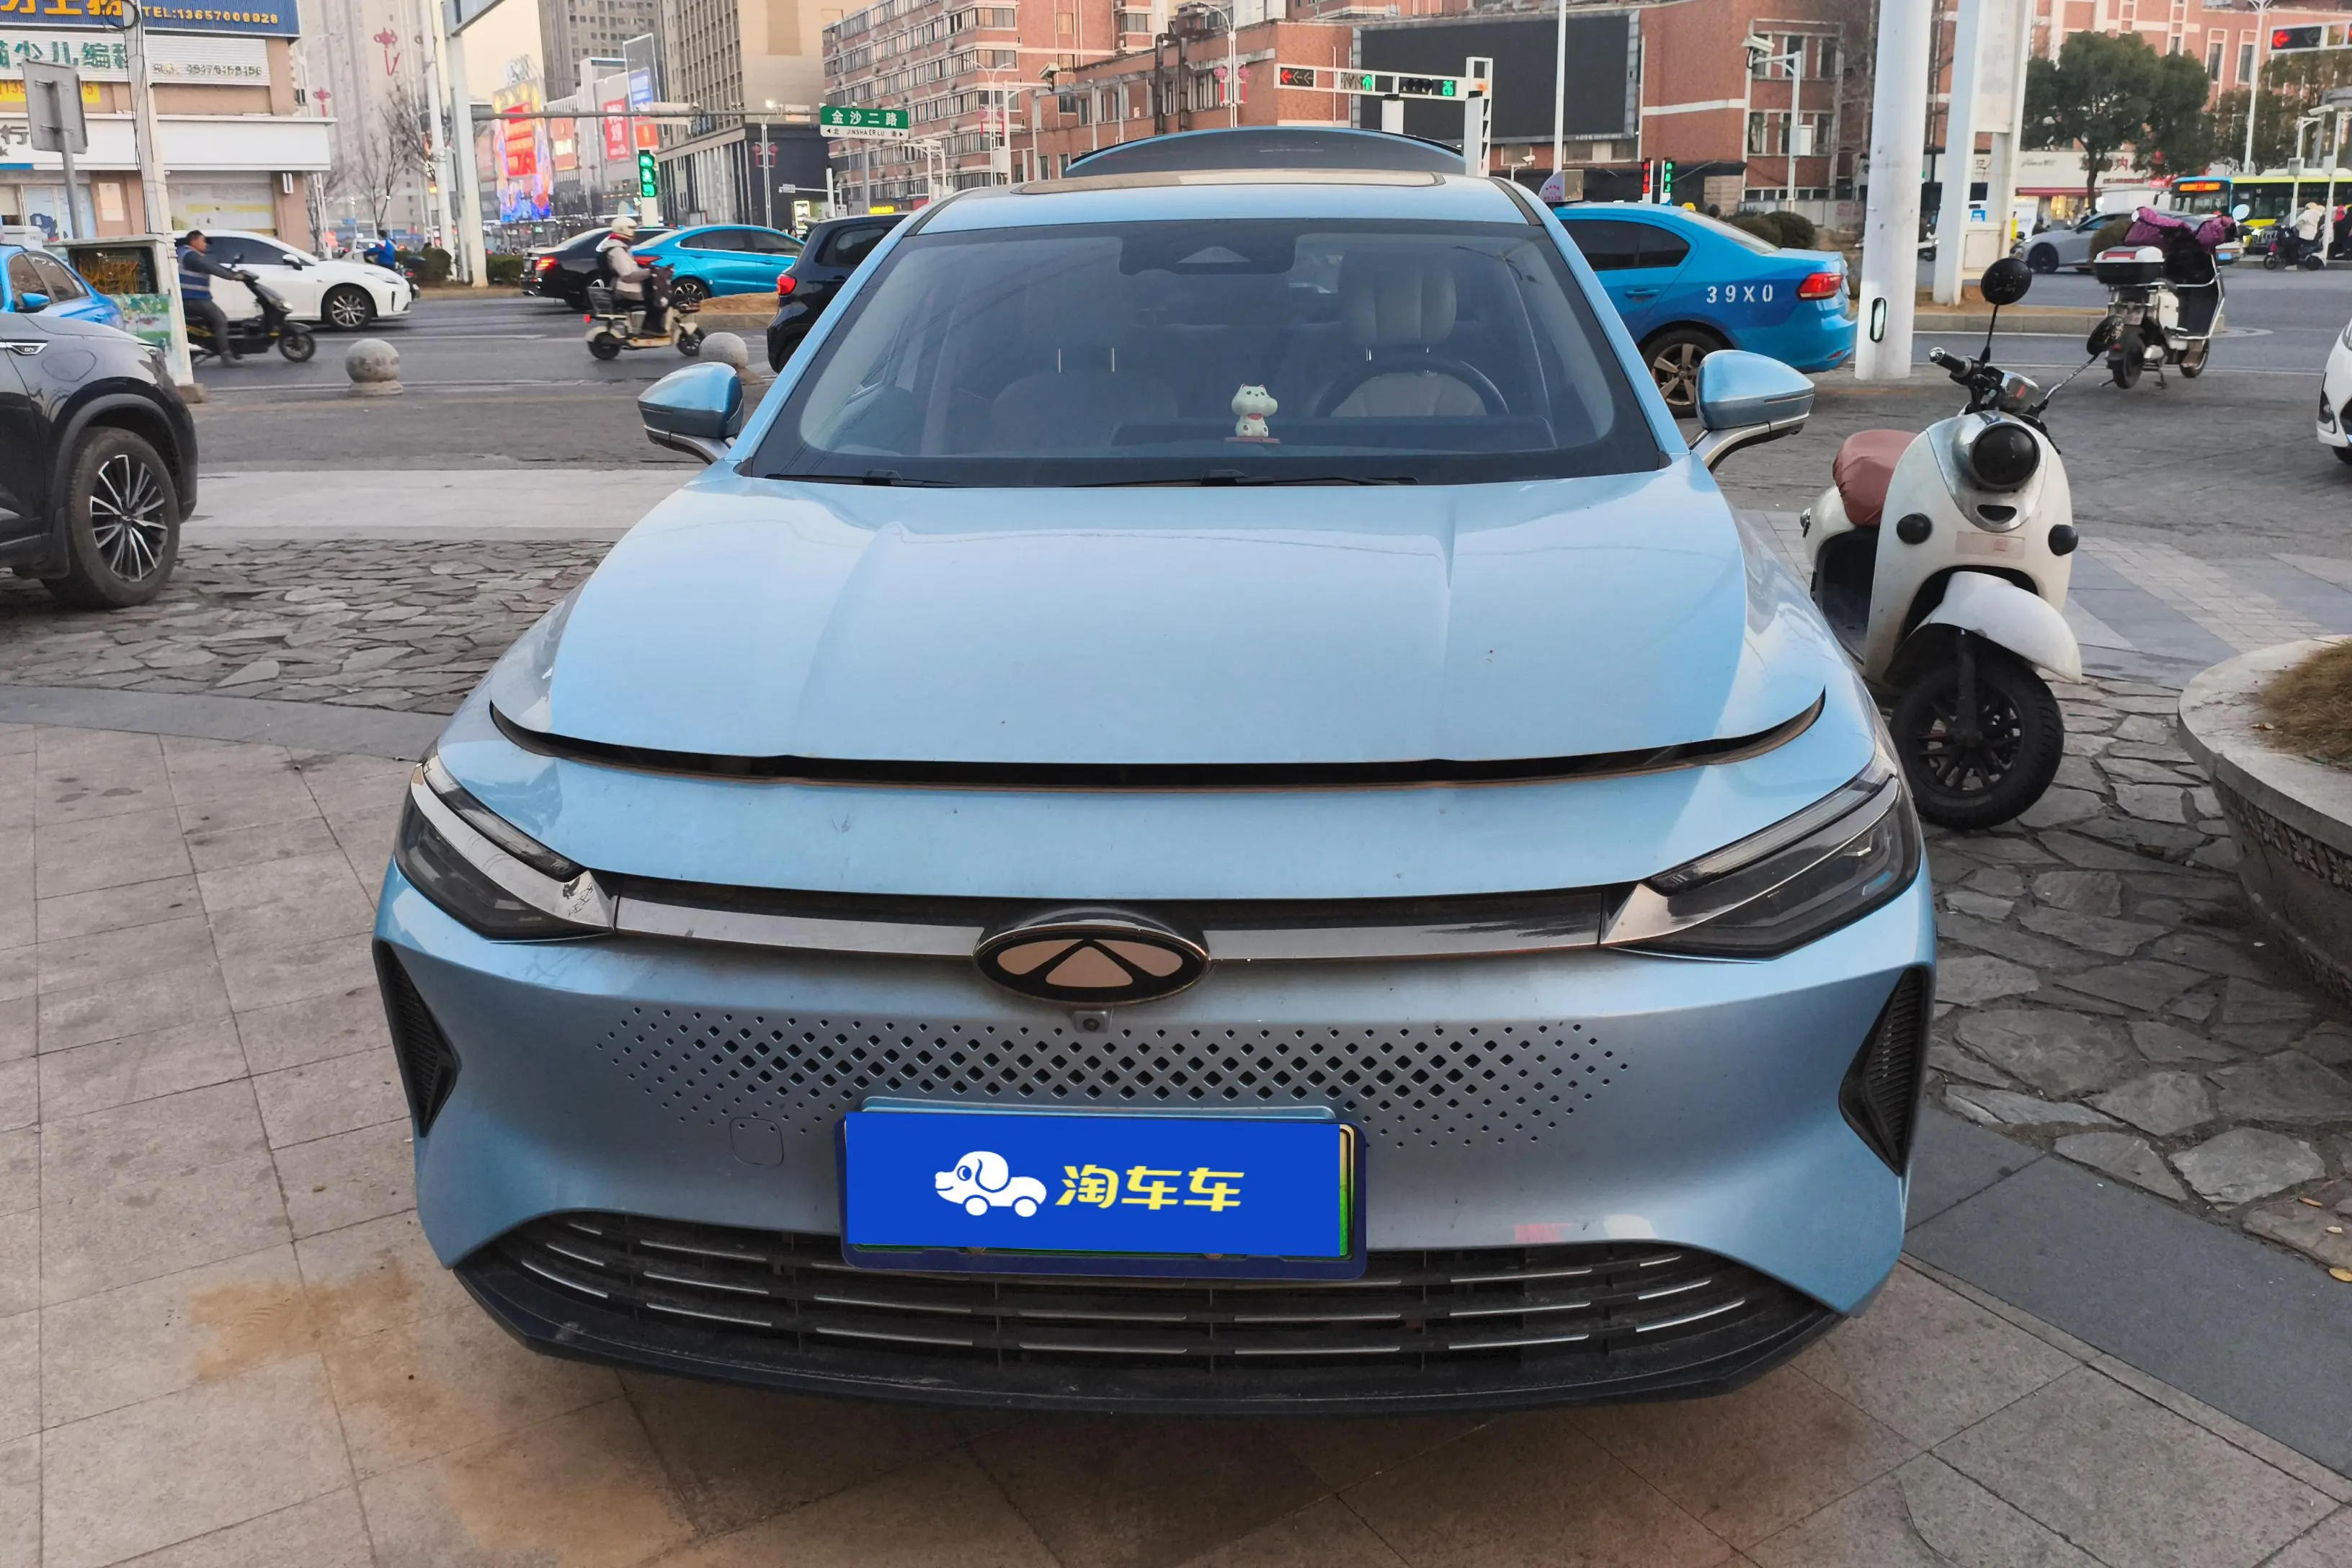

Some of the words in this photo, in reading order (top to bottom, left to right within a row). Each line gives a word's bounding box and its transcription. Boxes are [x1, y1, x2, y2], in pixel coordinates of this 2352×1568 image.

[832, 110, 898, 127] 金沙二路
[1706, 285, 1773, 303] 39X0
